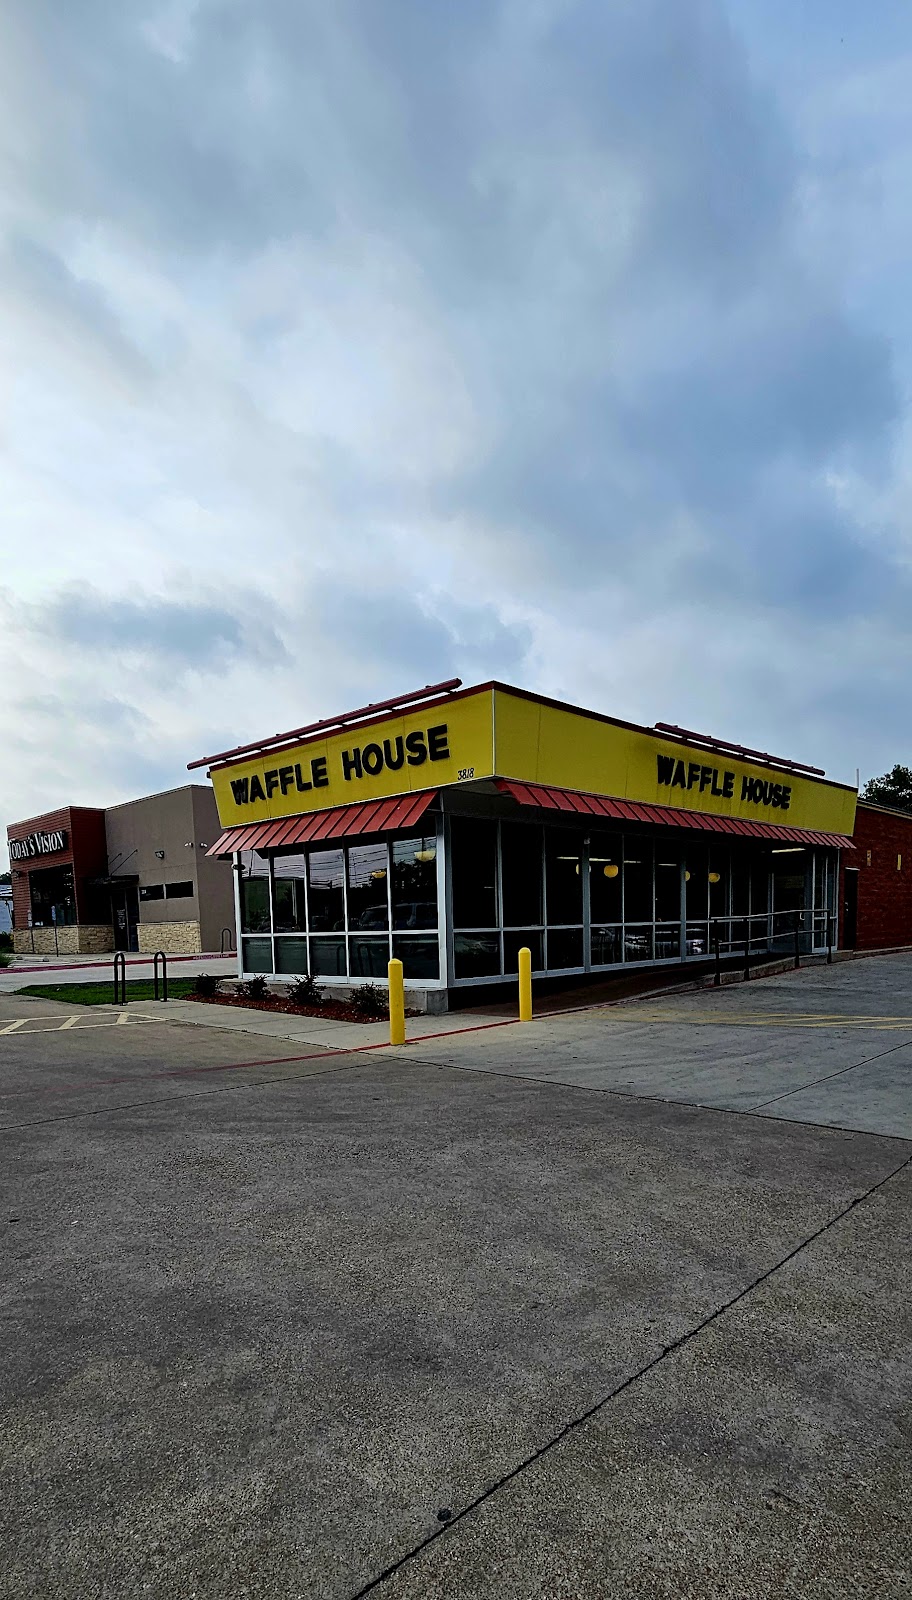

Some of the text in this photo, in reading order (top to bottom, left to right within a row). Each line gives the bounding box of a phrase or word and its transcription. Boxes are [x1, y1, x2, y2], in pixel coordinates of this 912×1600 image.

[230, 723, 450, 805] WAFFLE HOUSE
[457, 767, 475, 780] 3818
[656, 754, 792, 810] WAFFLE HOUSE
[8, 831, 64, 860] TODAY'S VISION
